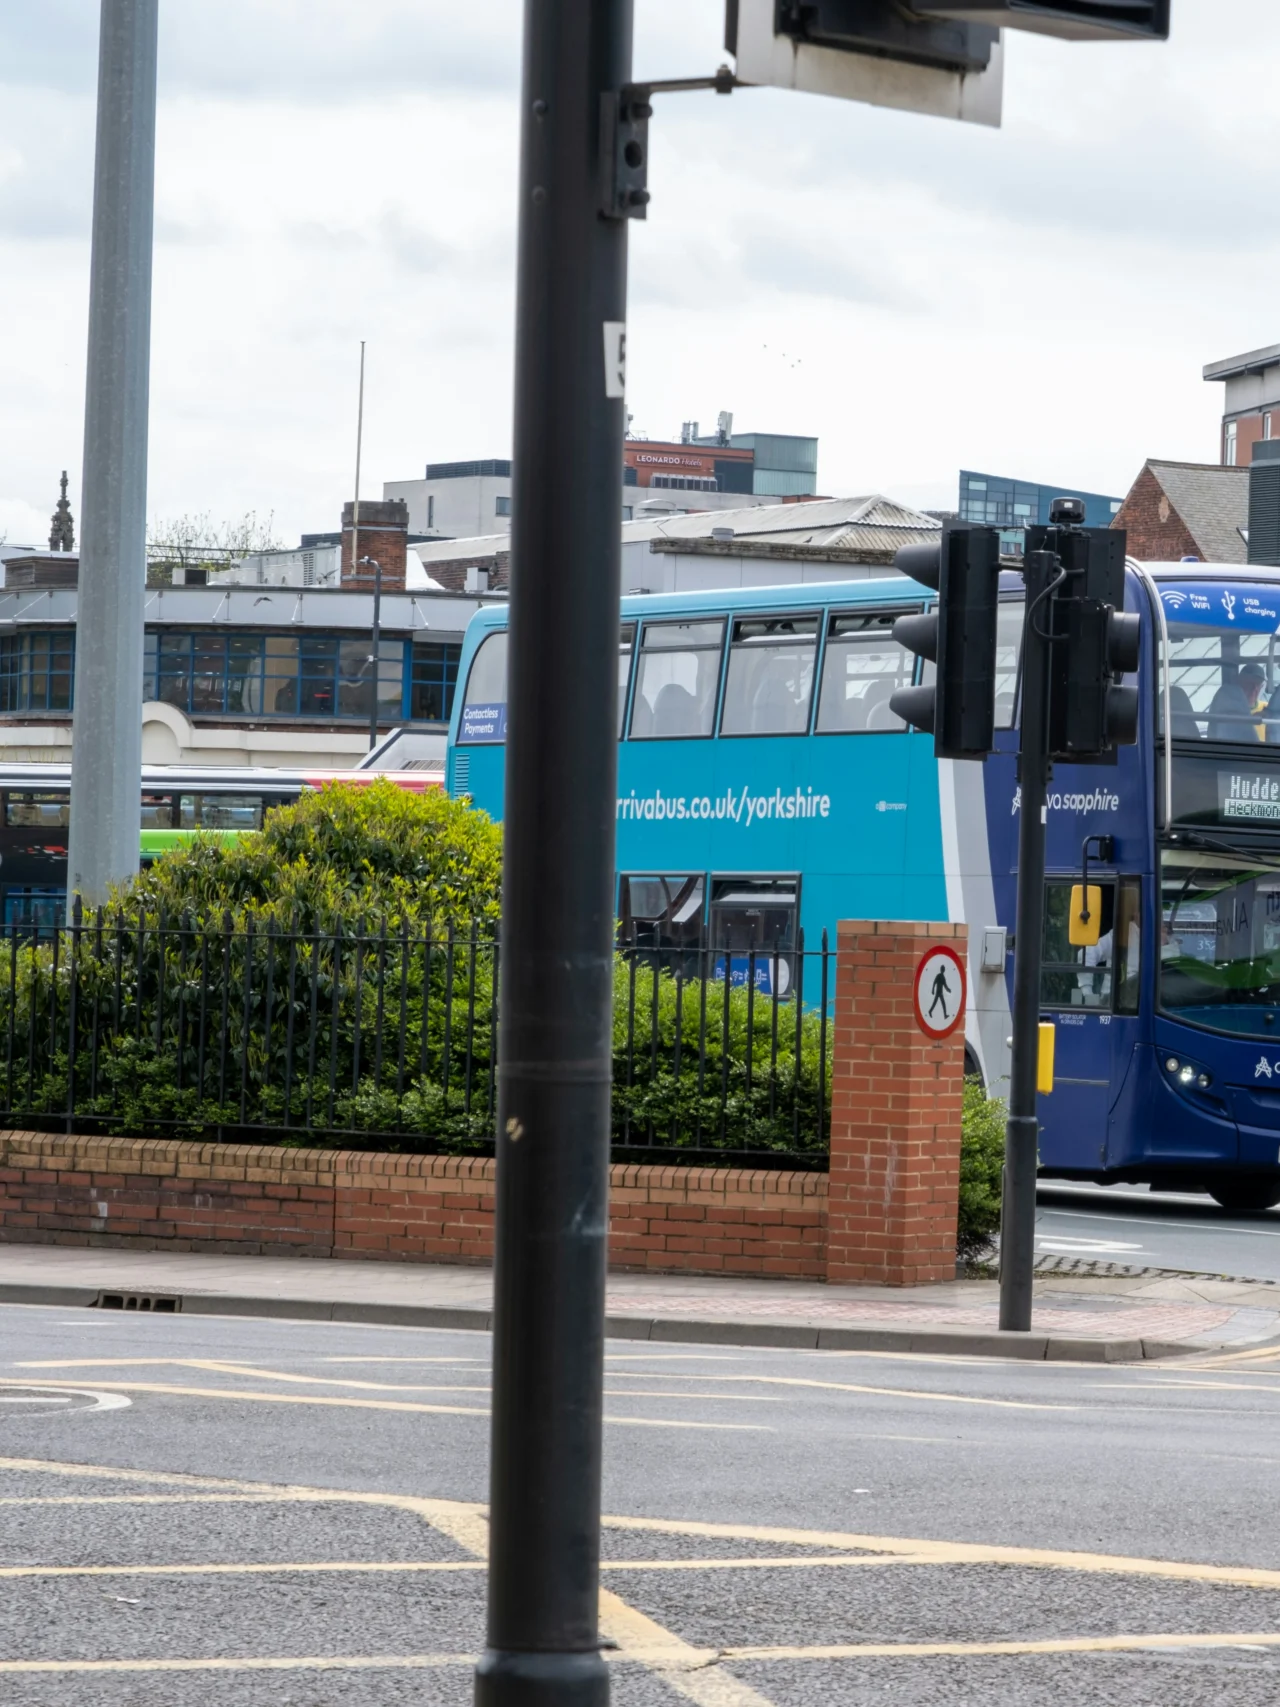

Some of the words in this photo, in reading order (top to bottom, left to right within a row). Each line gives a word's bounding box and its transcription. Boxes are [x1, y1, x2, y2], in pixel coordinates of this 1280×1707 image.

[636, 454, 681, 465] LEONARDO
[681, 457, 702, 466] Hotels
[1189, 593, 1208, 602] Free
[1242, 598, 1260, 606] USB
[1244, 606, 1276, 618] charging
[463, 707, 499, 720] Contactless
[464, 722, 495, 736] Payments
[1062, 788, 1119, 815] sapphire
